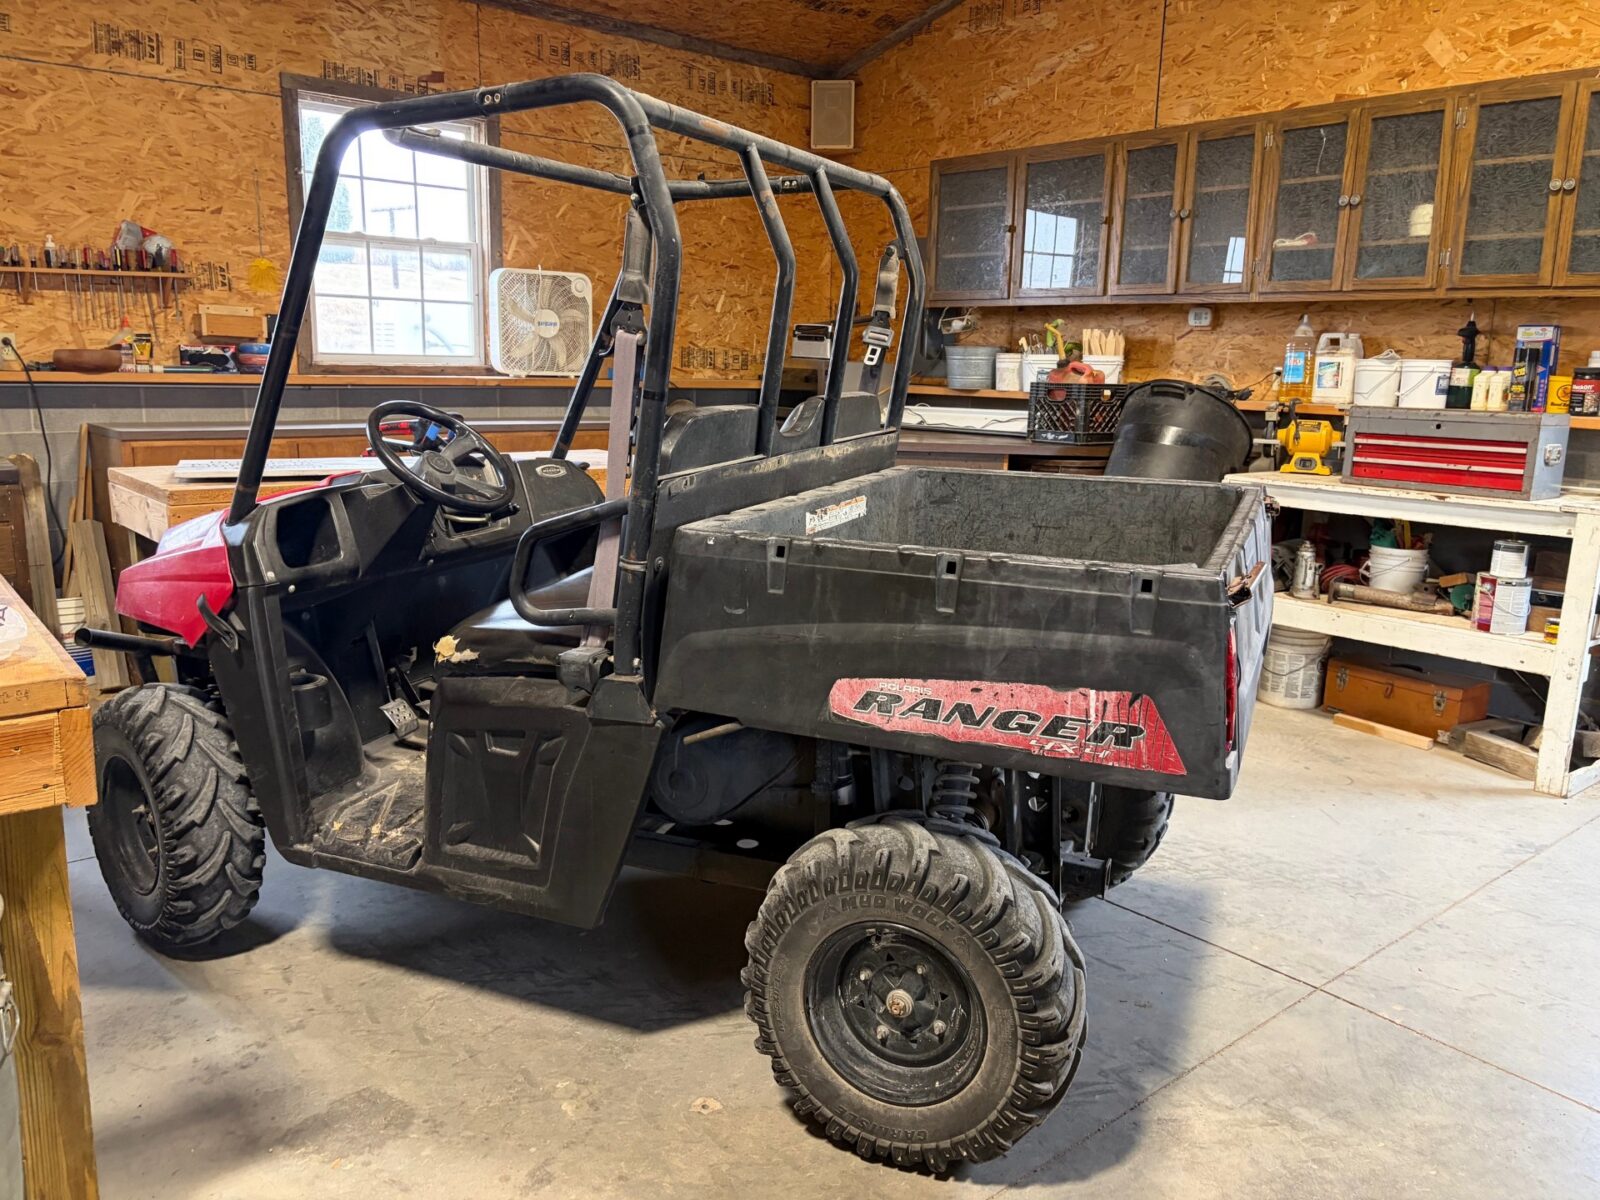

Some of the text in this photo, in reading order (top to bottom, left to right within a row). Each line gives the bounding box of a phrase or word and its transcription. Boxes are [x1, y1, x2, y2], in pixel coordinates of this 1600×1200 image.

[147, 35, 155, 59] APA
[879, 682, 932, 695] POLARIS
[853, 690, 1146, 750] RANGER
[840, 894, 886, 912] MUD
[894, 897, 956, 931] WOLF
[833, 1104, 929, 1141] CARLISLE
